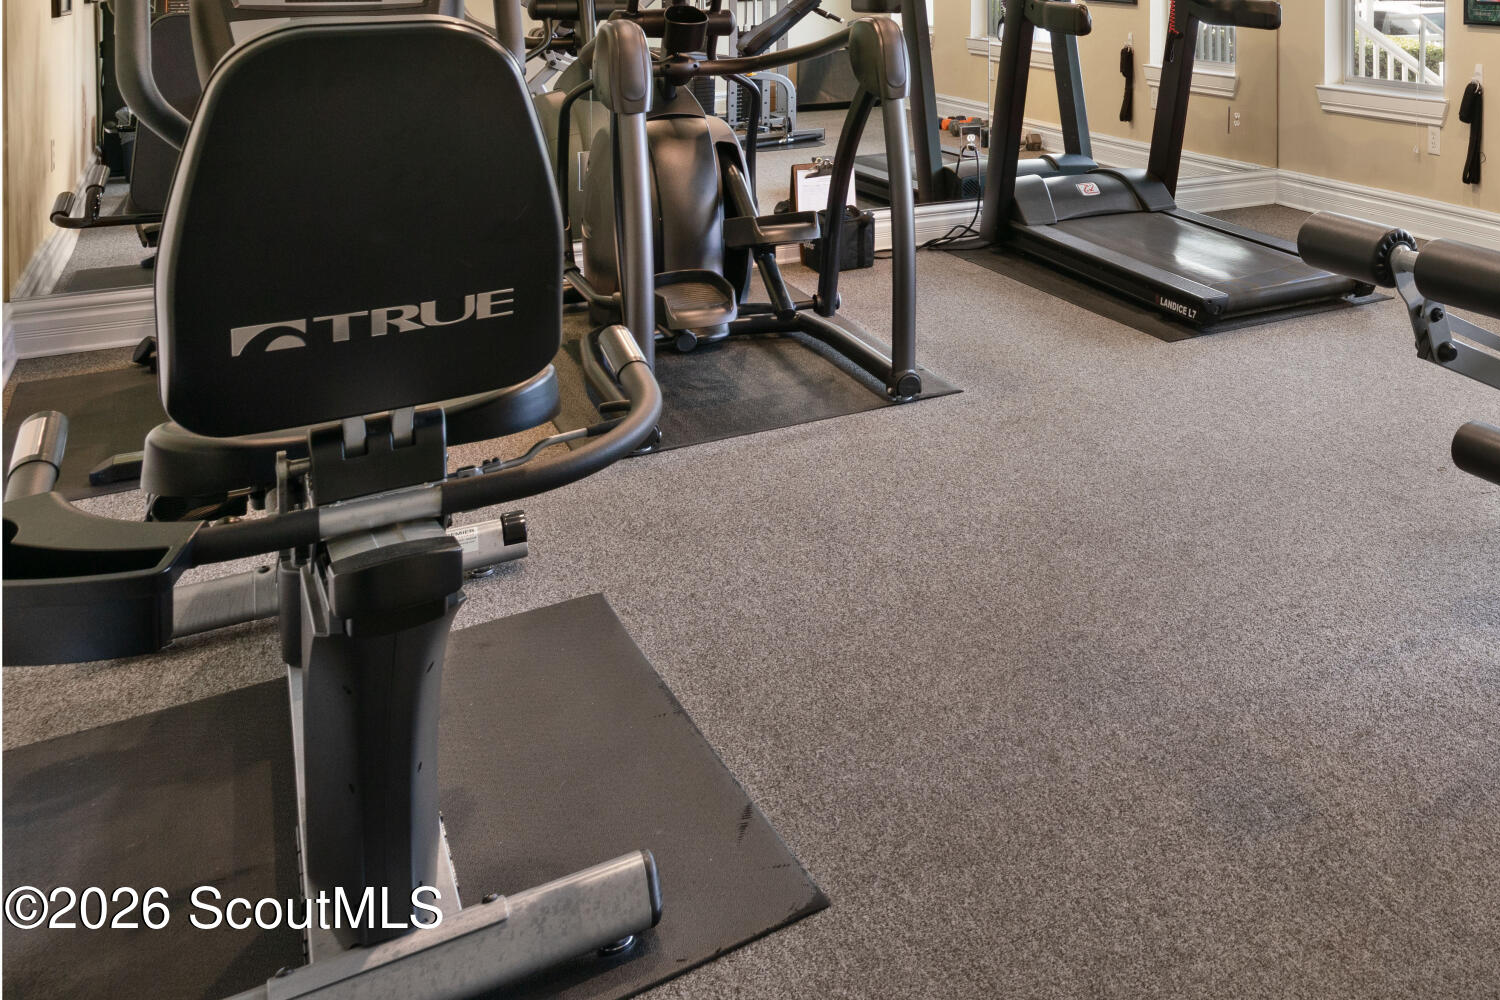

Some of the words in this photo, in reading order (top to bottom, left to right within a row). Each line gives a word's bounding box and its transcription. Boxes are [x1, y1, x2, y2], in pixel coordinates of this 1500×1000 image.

[313, 287, 514, 343] TRUE
[1160, 297, 1187, 316] LANDICE
[1188, 308, 1197, 319] L7
